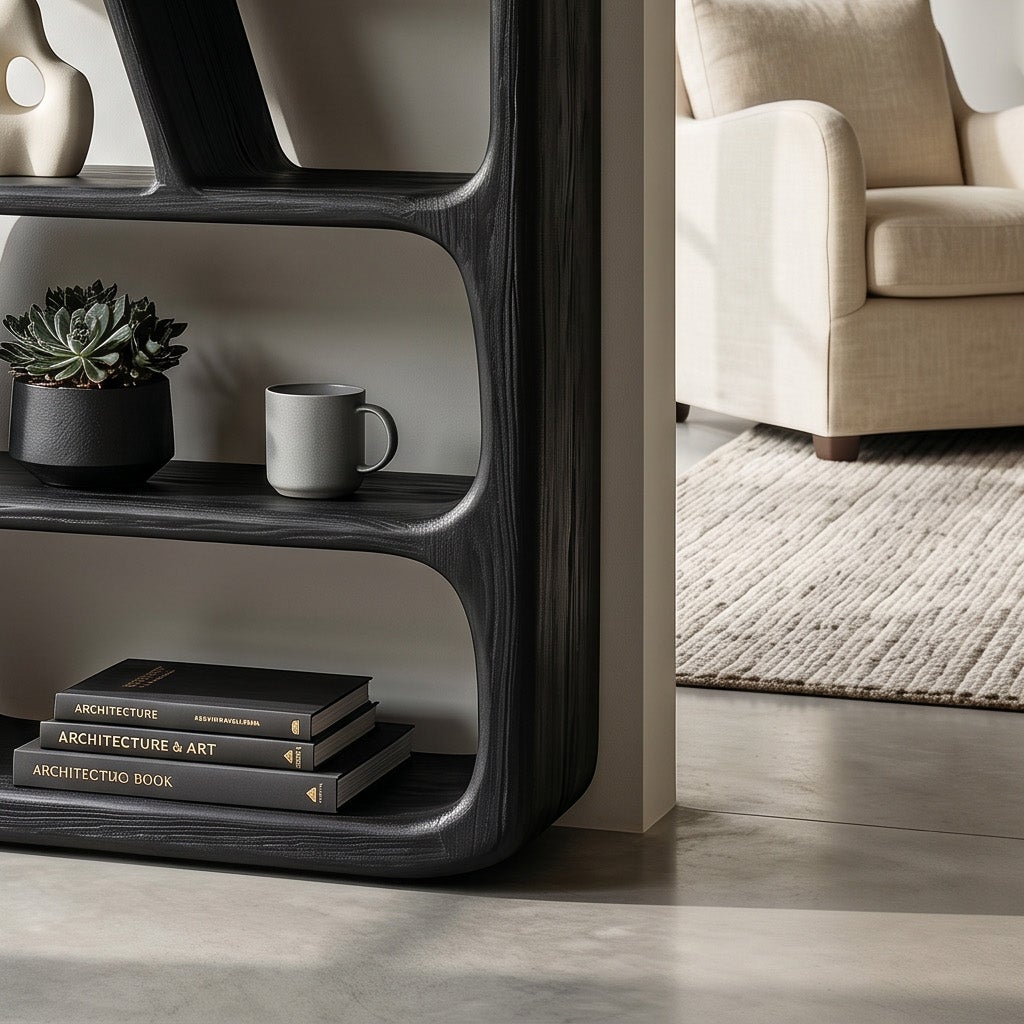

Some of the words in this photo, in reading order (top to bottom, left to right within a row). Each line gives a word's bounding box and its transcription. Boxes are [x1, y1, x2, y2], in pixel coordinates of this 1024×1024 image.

[74, 703, 158, 720] ARCHITECTURE
[58, 730, 169, 752] ARCHITECTURE
[186, 742, 217, 756] ART
[134, 773, 173, 788] BOOK
